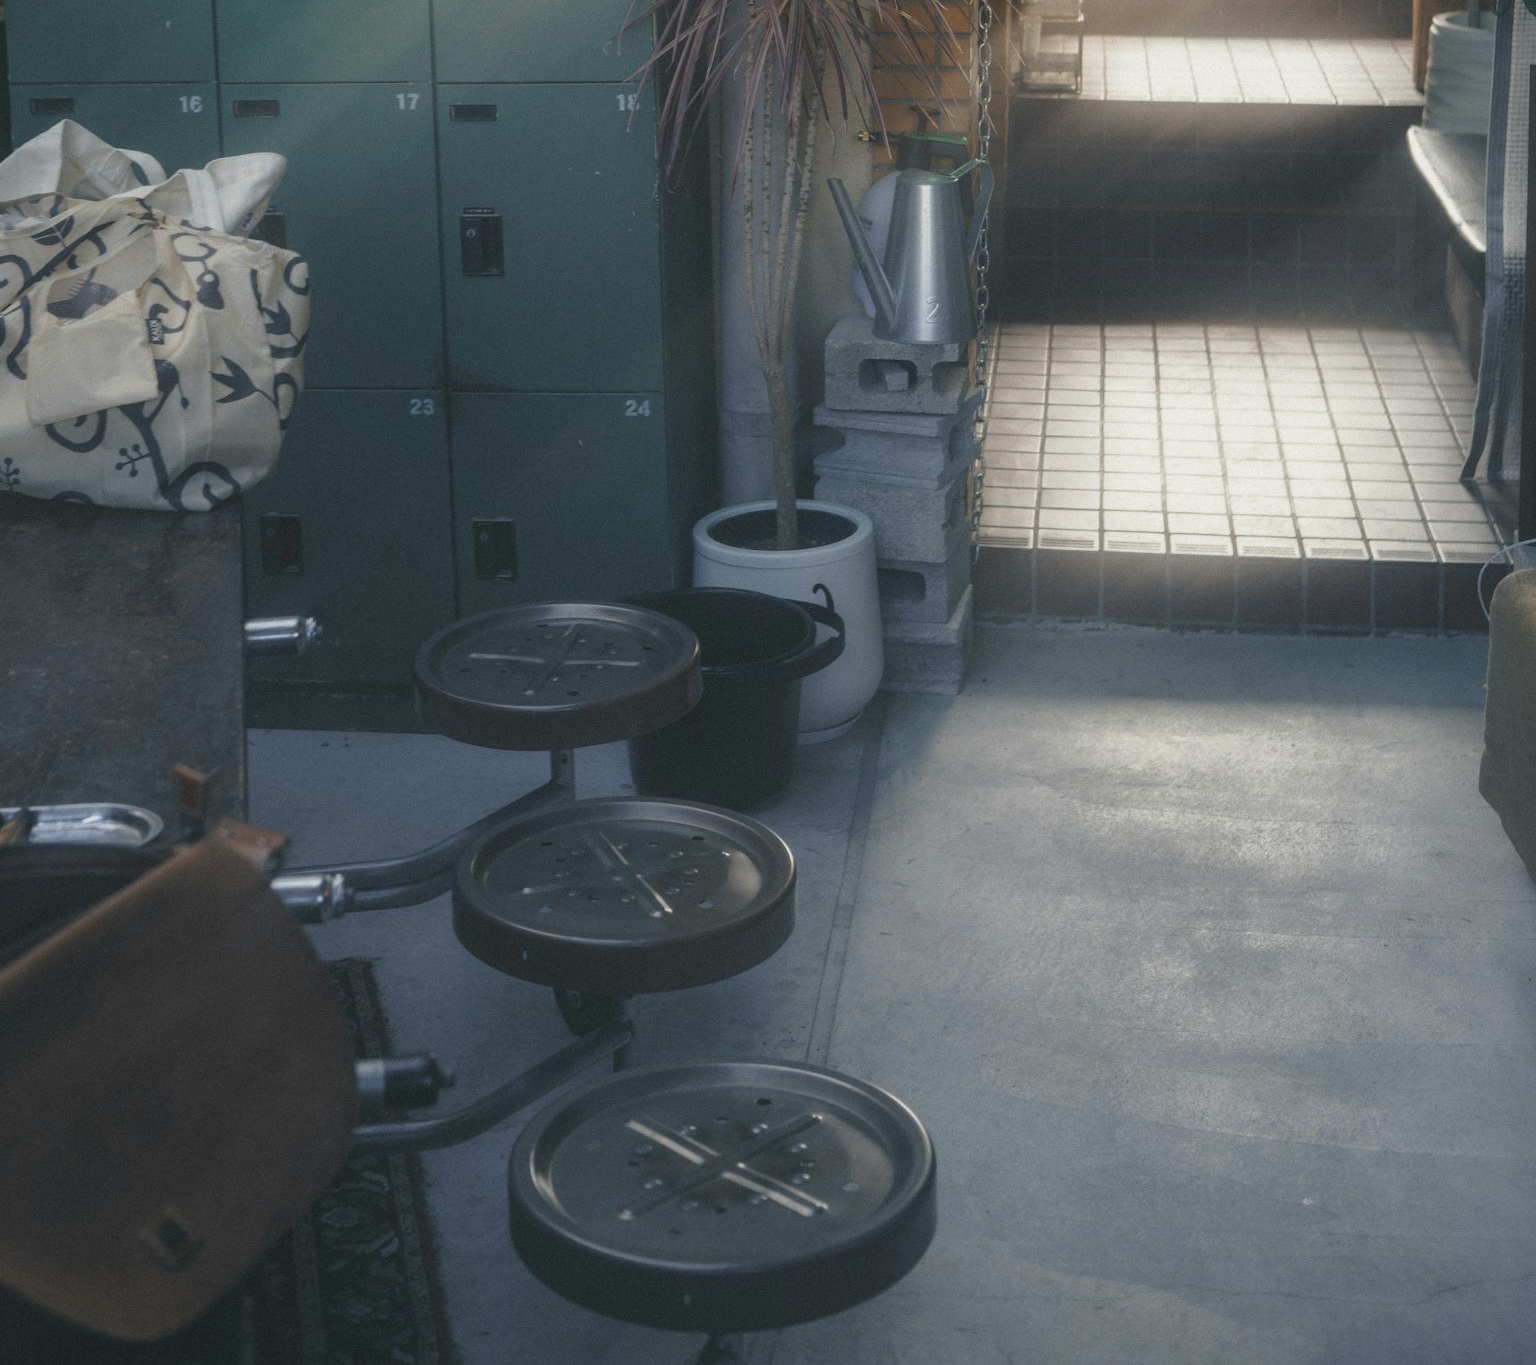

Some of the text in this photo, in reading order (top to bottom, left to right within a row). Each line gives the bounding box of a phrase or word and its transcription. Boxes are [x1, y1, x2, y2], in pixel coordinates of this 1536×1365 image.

[179, 95, 203, 114] 16
[397, 93, 419, 110] 17
[616, 94, 640, 111] 18
[409, 398, 434, 415] 23
[625, 399, 651, 417] 24
